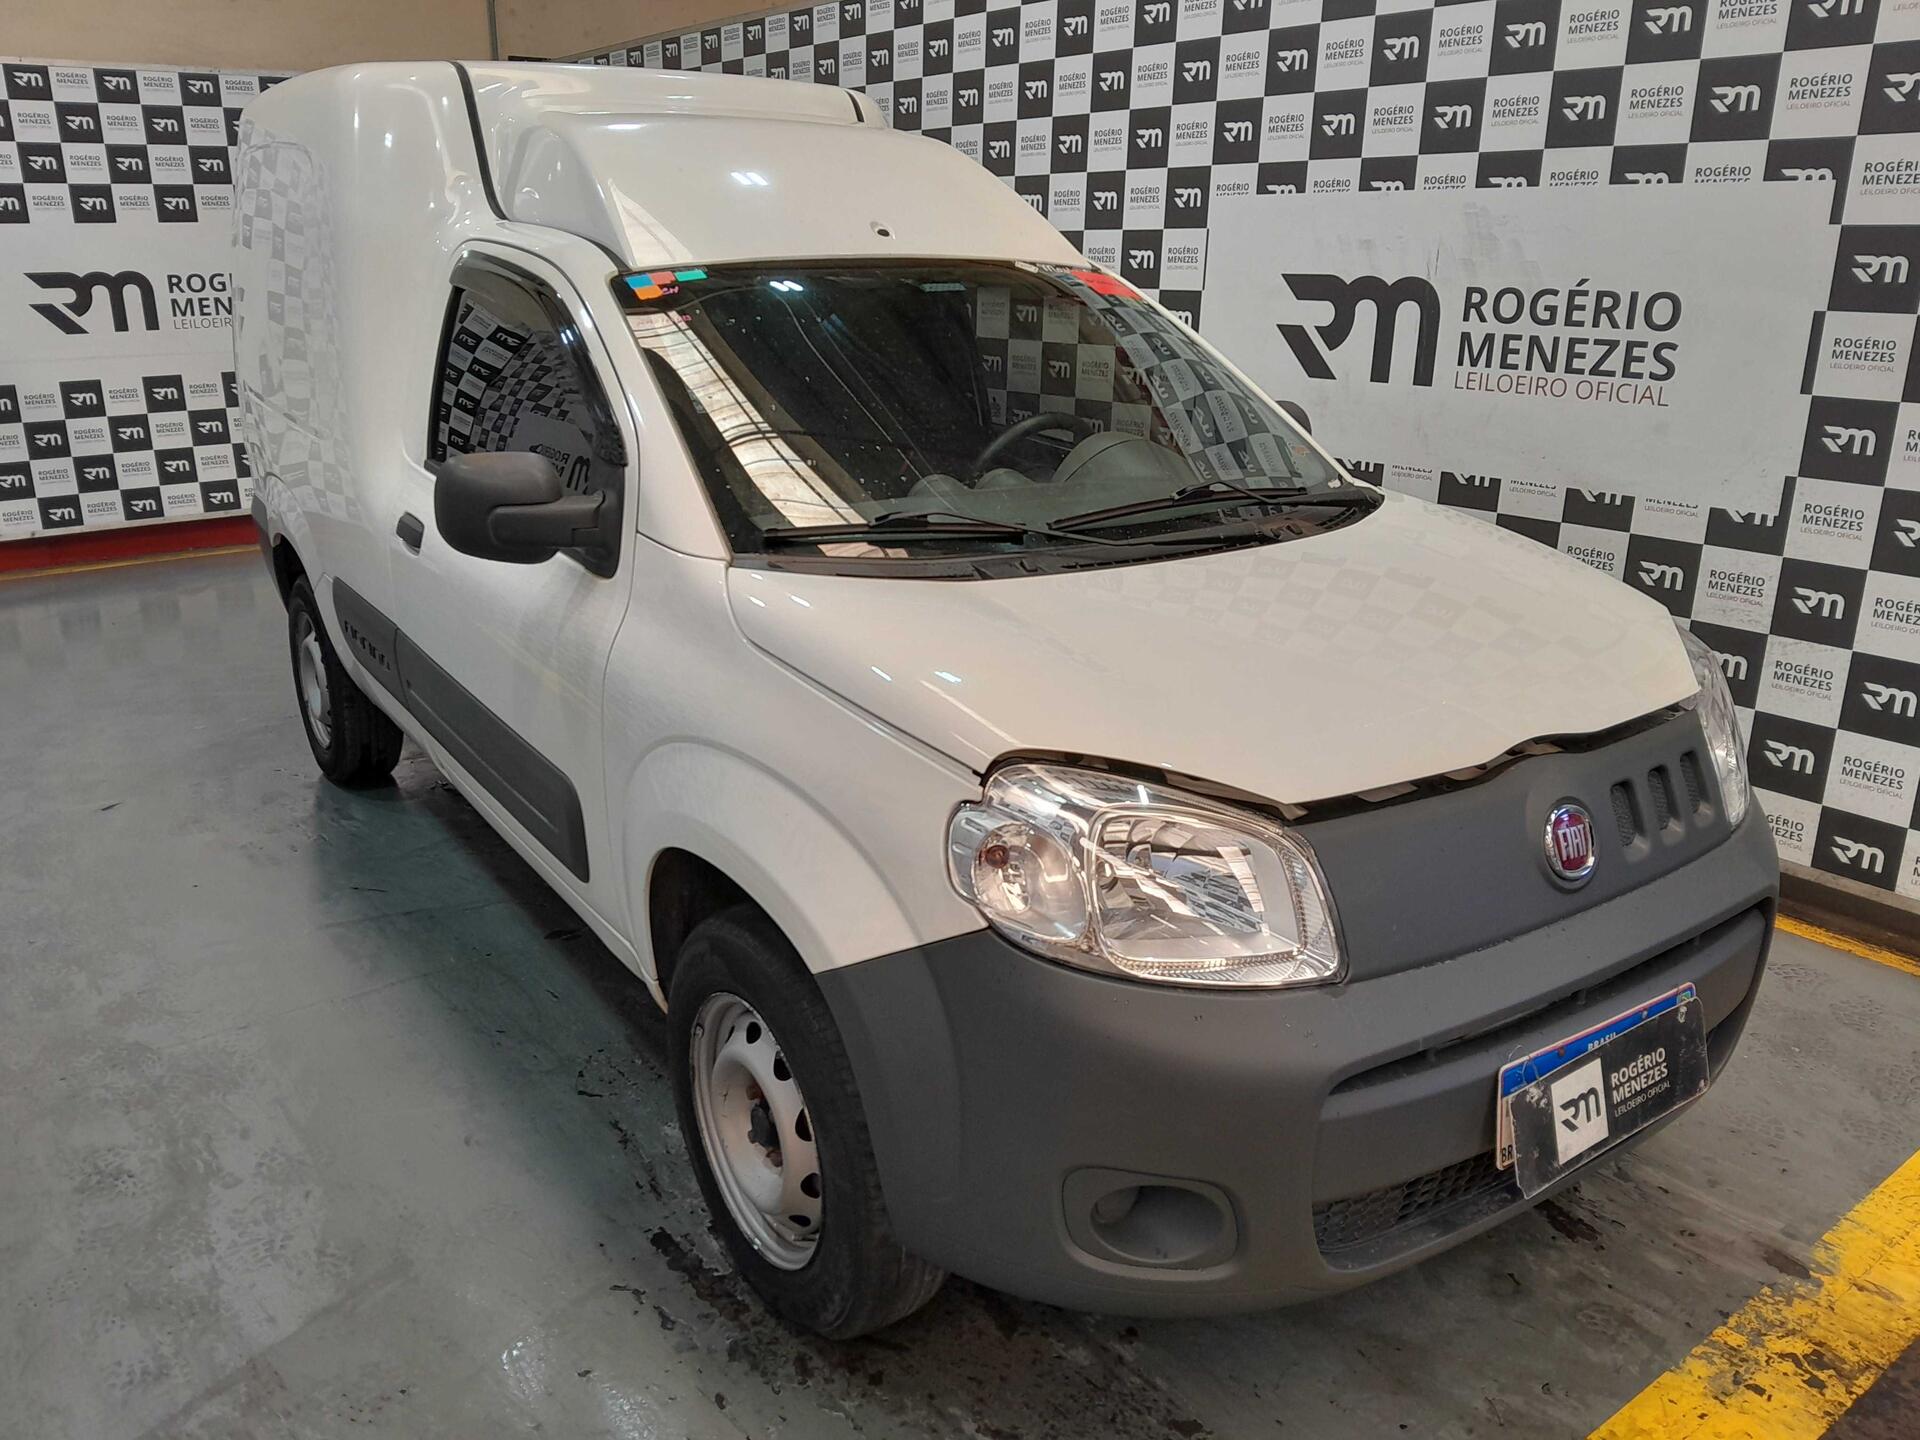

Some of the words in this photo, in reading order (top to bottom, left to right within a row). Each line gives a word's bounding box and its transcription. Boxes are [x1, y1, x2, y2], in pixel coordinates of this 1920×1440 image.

[1100, 5, 1130, 17] ROGÉRIO
[1569, 9, 1620, 24] ROGÉRIO
[1024, 18, 1051, 29] ROGÉRIO
[1099, 13, 1129, 25] MENEZES
[1024, 26, 1051, 37] MENEZES
[1439, 24, 1483, 38] ROGÉRIO
[1567, 20, 1619, 34] MENEZES
[957, 29, 981, 40] ROGÉRIO
[897, 40, 919, 51] ROGÉRIO
[957, 37, 981, 48] MENEZES
[1325, 38, 1365, 51] ROGÉRIO
[1438, 34, 1483, 48] MENEZES
[897, 48, 919, 58] MENEZES
[1225, 50, 1260, 63] ROGÉRIO
[1324, 48, 1364, 60] MENEZES
[1137, 62, 1168, 73] ROGÉRIO
[1225, 59, 1260, 72] MENEZES
[55, 71, 87, 79] ROGÉRIO
[1058, 72, 1086, 82] ROGÉRIO
[1136, 70, 1168, 82] MENEZES
[1789, 73, 1853, 88] ROGÉRIO
[56, 77, 89, 85] MENEZES
[988, 81, 1013, 91] ROGÉRIO
[1058, 80, 1086, 90] MENEZES
[925, 89, 948, 99] ROGÉRIO
[988, 88, 1013, 99] MENEZES
[1630, 84, 1684, 98] ROGÉRIO
[1787, 85, 1851, 100] MENEZES
[925, 97, 948, 106] MENEZES
[1493, 95, 1540, 108] ROGÉRIO
[1629, 96, 1683, 110] MENEZES
[1373, 105, 1414, 116] ROGÉRIO
[1491, 106, 1539, 118] MENEZES
[1268, 113, 1305, 124] ROGÉRIO
[1372, 115, 1413, 126] MENEZES
[1176, 120, 1208, 131] ROGÉRIO
[1267, 122, 1304, 133] MENEZES
[1020, 134, 1046, 143] ROGÉRIO
[1094, 128, 1123, 138] ROGÉRIO
[1175, 129, 1208, 140] MENEZES
[1020, 142, 1046, 151] MENEZES
[1093, 136, 1122, 146] MENEZES
[1549, 168, 1599, 181] ROGÉRIO
[1695, 165, 1752, 177] ROGÉRIO
[1313, 178, 1351, 189] ROGÉRIO
[1423, 174, 1467, 185] ROGÉRIO
[1130, 185, 1160, 195] ROGÉRIO
[1216, 182, 1250, 192] ROGÉRIO
[1053, 189, 1081, 198] ROGÉRIO
[1129, 194, 1160, 204] MENEZES
[1053, 197, 1080, 206] MENEZES
[1167, 245, 1199, 255] ROGÉRIO
[1167, 255, 1199, 264] MENEZES
[1461, 279, 1682, 332] ROGÉRIO
[1833, 336, 1897, 351] ROGÉRIO
[1456, 331, 1677, 381] MENEZES
[1831, 349, 1895, 363] MENEZES
[108, 387, 138, 395] ROGÉRIO
[1454, 371, 1567, 397] LEILOEIRO
[1577, 381, 1670, 408] OFICIAL
[109, 392, 139, 400] MENEZES
[155, 421, 184, 429] ROGÉRIO
[155, 426, 185, 434] MENEZES
[73, 427, 103, 435] ROGÉRIO
[1803, 502, 1864, 520] ROGÉRIO
[1801, 513, 1863, 532] MENEZES
[1566, 545, 1615, 562] ROGÉRIO
[1709, 569, 1765, 587] ROGÉRIO
[1707, 579, 1764, 598] MENEZES
[1775, 659, 1834, 680] ROGÉRIO
[1773, 670, 1832, 691] MENEZES
[1843, 755, 1905, 779] ROGÉRIO
[1841, 766, 1903, 790] MENEZES
[1558, 823, 1587, 861] FIAT
[1611, 1047, 1666, 1087] ROGÉRIO
[1613, 1062, 1668, 1104] MENEZES
